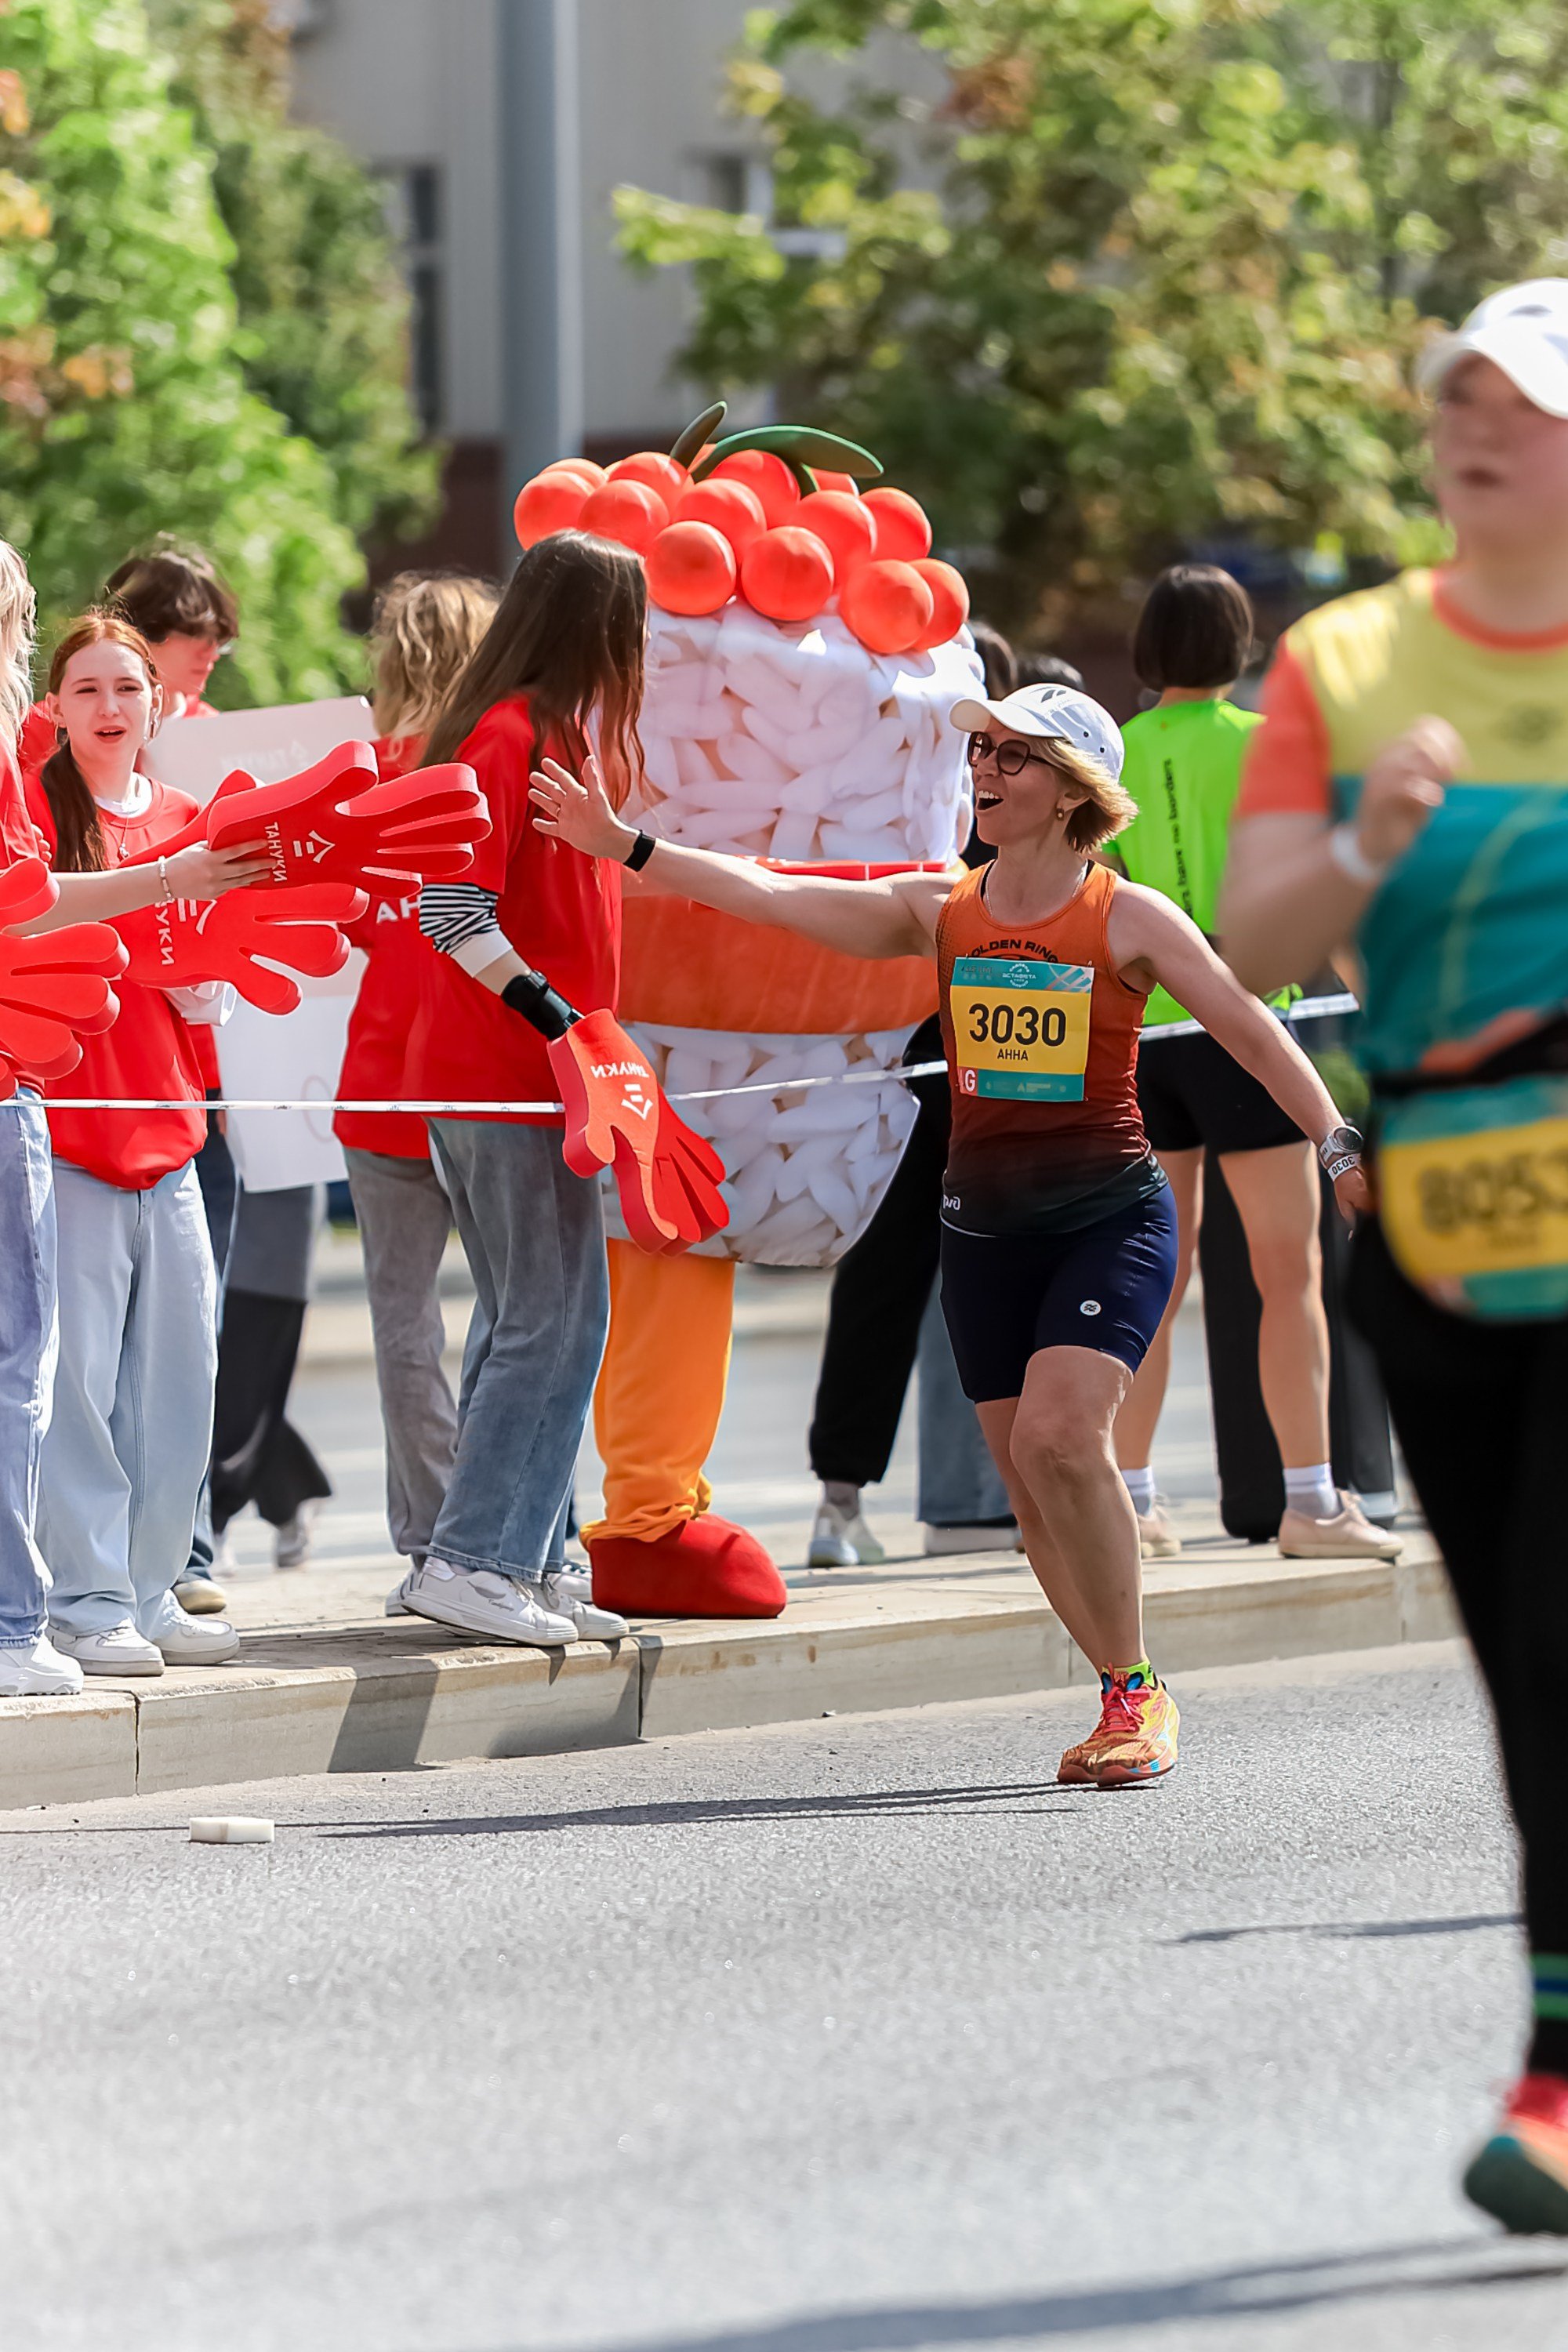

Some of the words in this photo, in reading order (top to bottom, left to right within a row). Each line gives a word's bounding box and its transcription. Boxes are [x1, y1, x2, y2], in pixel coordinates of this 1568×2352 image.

[1163, 758, 1178, 820] borders
[264, 822, 288, 882] ТАНУКИ
[154, 902, 175, 965] УКИ
[969, 1003, 1066, 1047] 3030
[996, 1048, 1029, 1061] АННА
[1331, 1156, 1355, 1174] 3030
